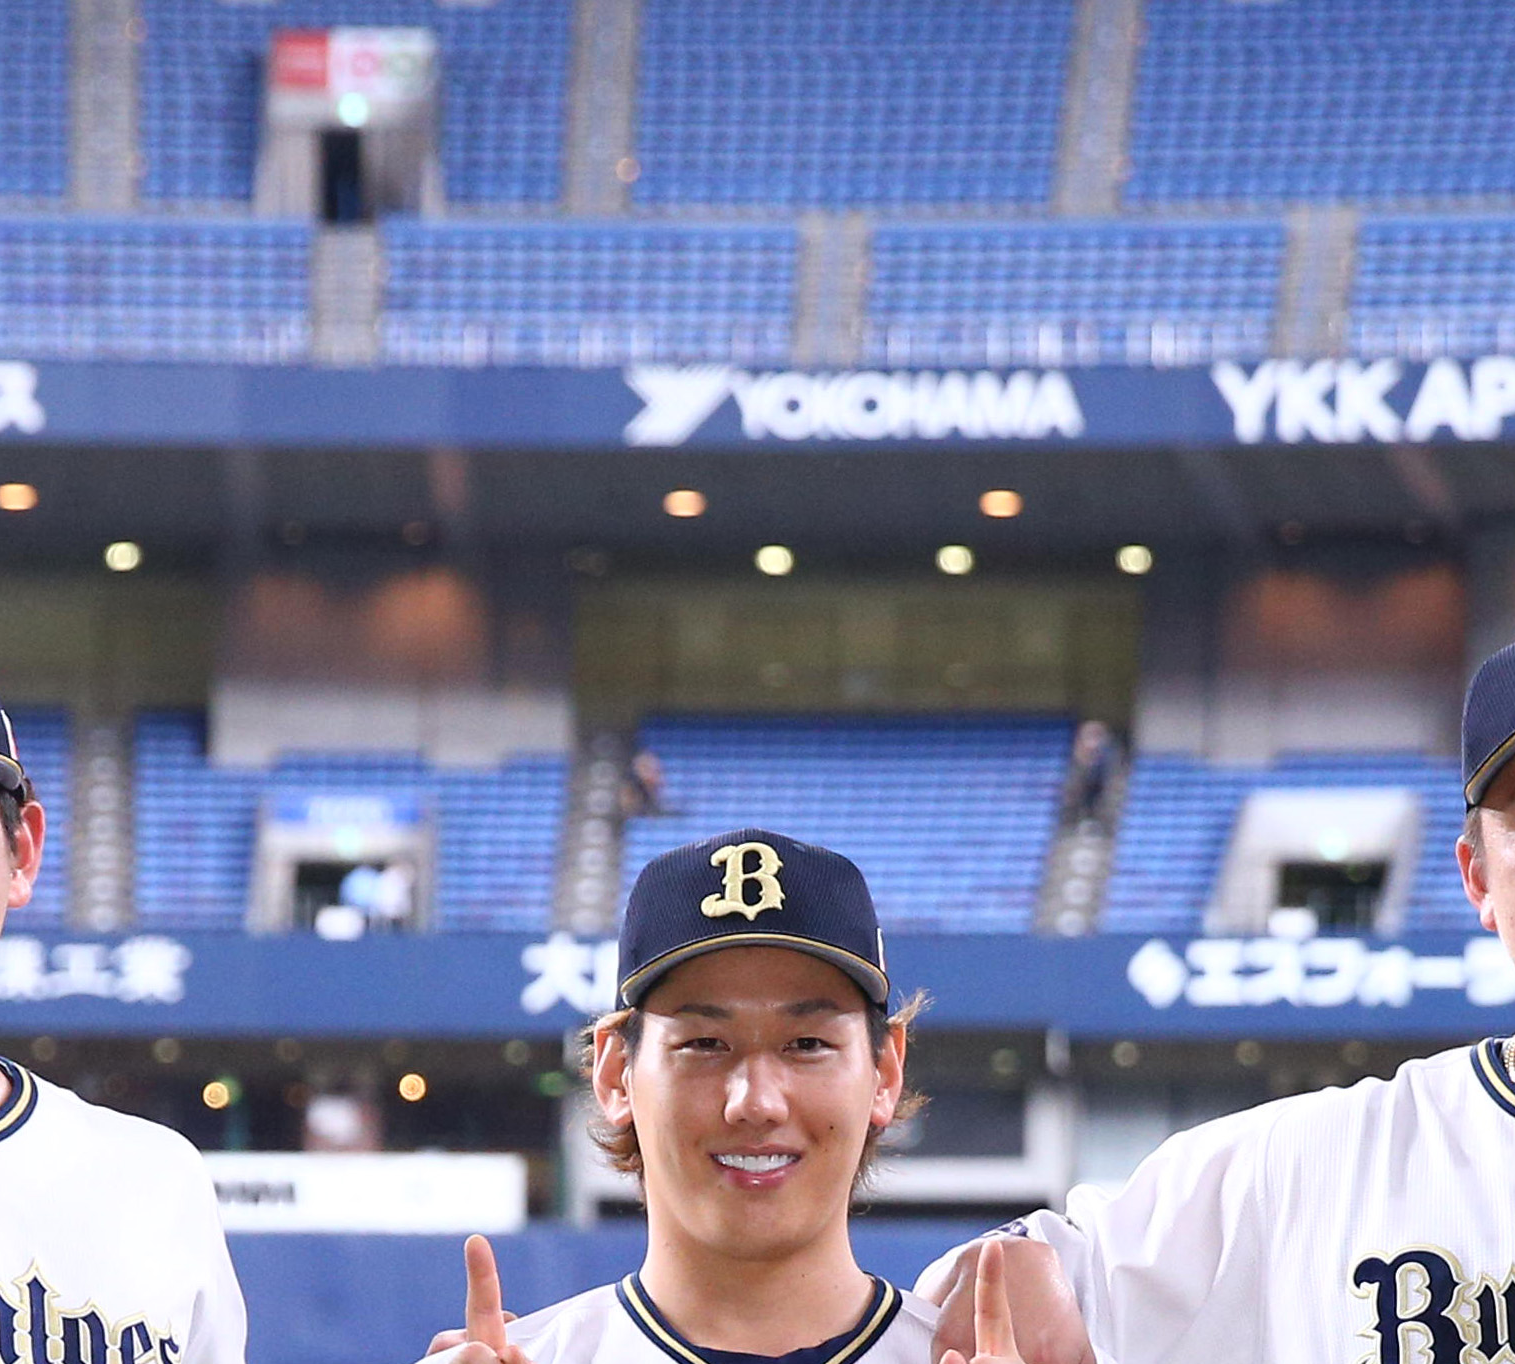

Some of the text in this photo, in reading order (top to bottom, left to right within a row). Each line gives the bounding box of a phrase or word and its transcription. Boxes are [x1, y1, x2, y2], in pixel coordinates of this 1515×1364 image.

[729, 370, 1083, 442] YOKOHAMA
[1212, 357, 1402, 443] YKK
[701, 842, 786, 921] B
